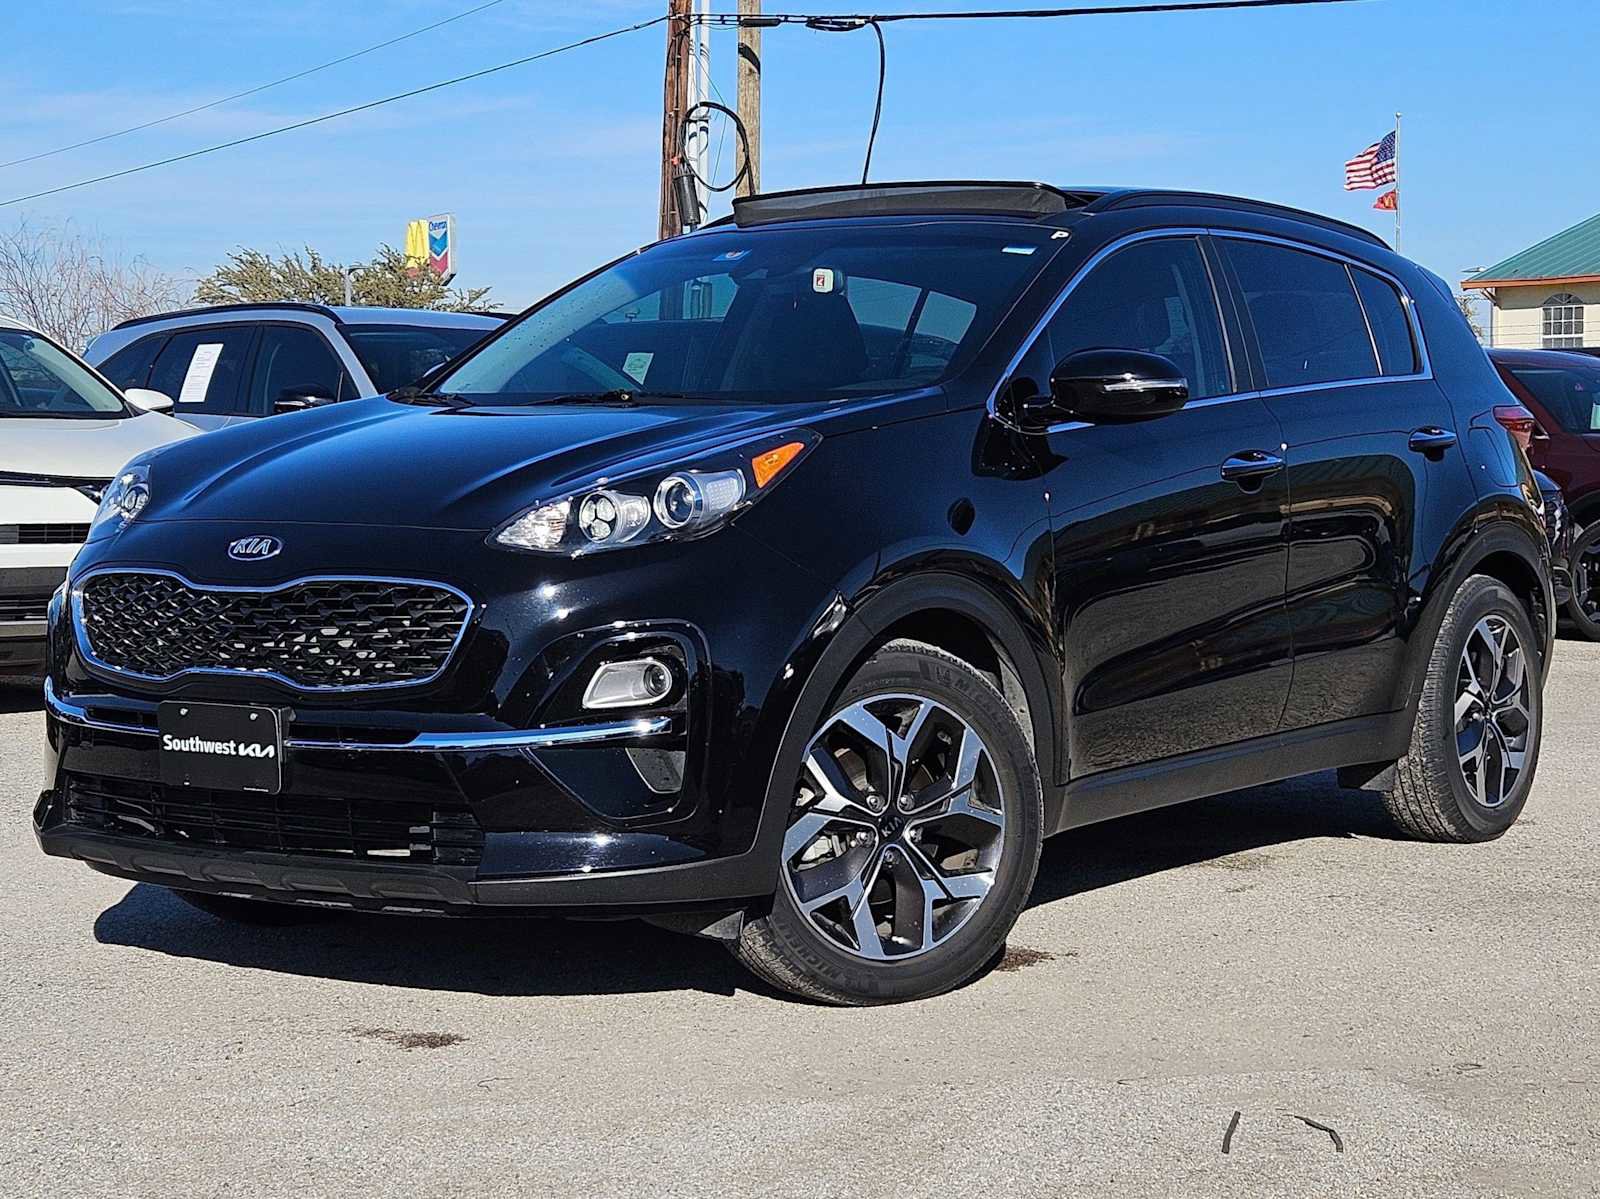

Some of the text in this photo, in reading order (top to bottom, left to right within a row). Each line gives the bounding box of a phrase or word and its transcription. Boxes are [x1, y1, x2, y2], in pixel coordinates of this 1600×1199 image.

[429, 220, 447, 231] Chevron
[232, 538, 272, 555] KIA
[162, 734, 237, 755] Southwest
